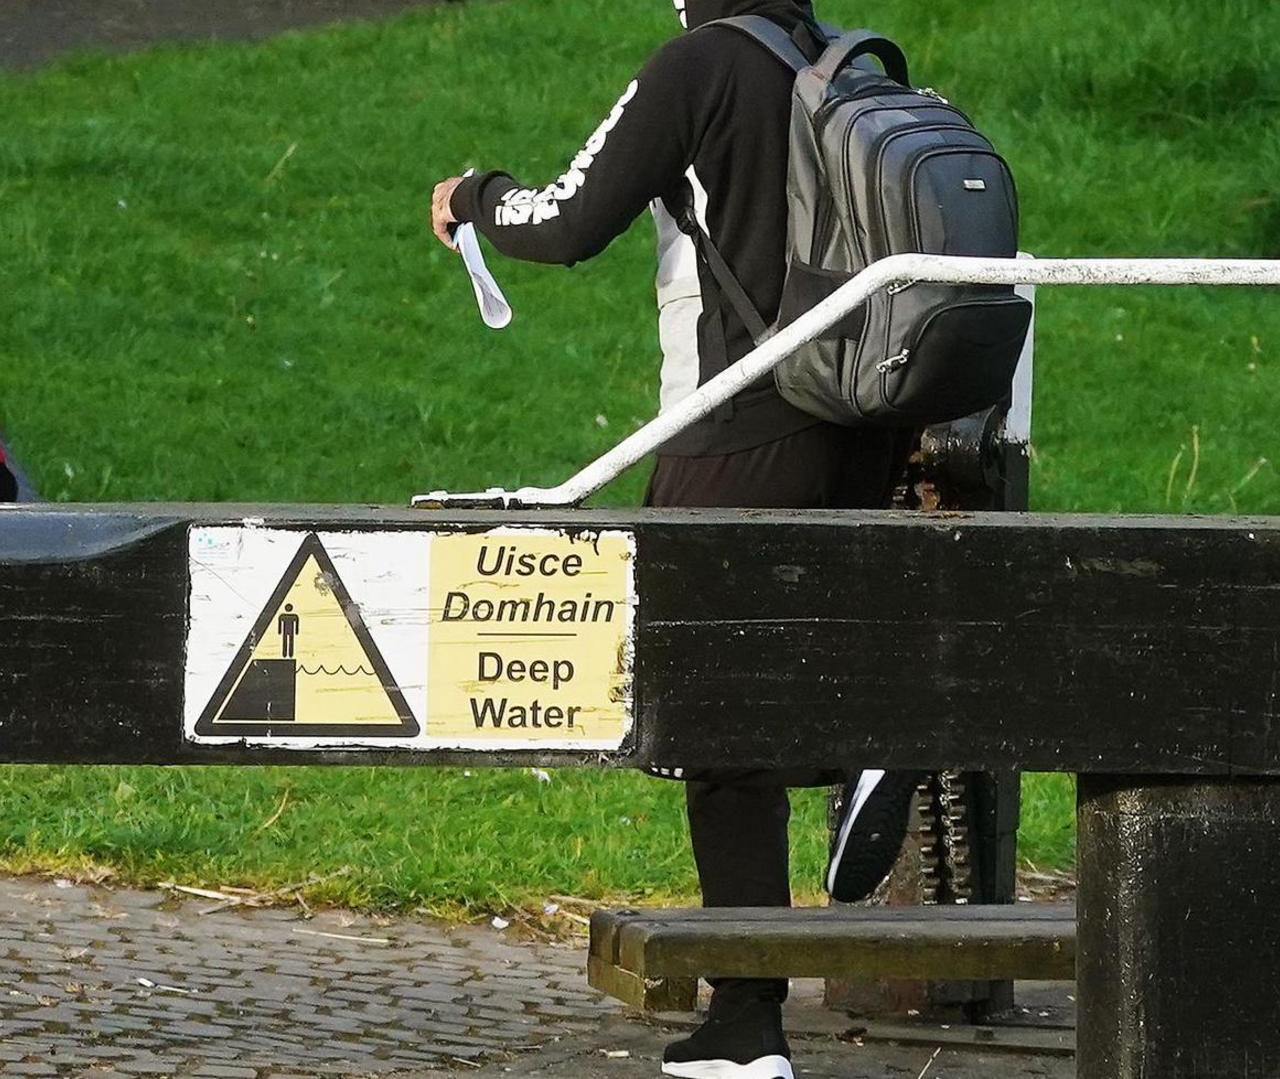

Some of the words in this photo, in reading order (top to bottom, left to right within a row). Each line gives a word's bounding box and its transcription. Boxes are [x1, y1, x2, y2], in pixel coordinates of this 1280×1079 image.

[476, 545, 583, 576] Uisce
[442, 591, 615, 623] Domhain
[477, 651, 575, 689] Deep
[470, 697, 581, 729] Water
